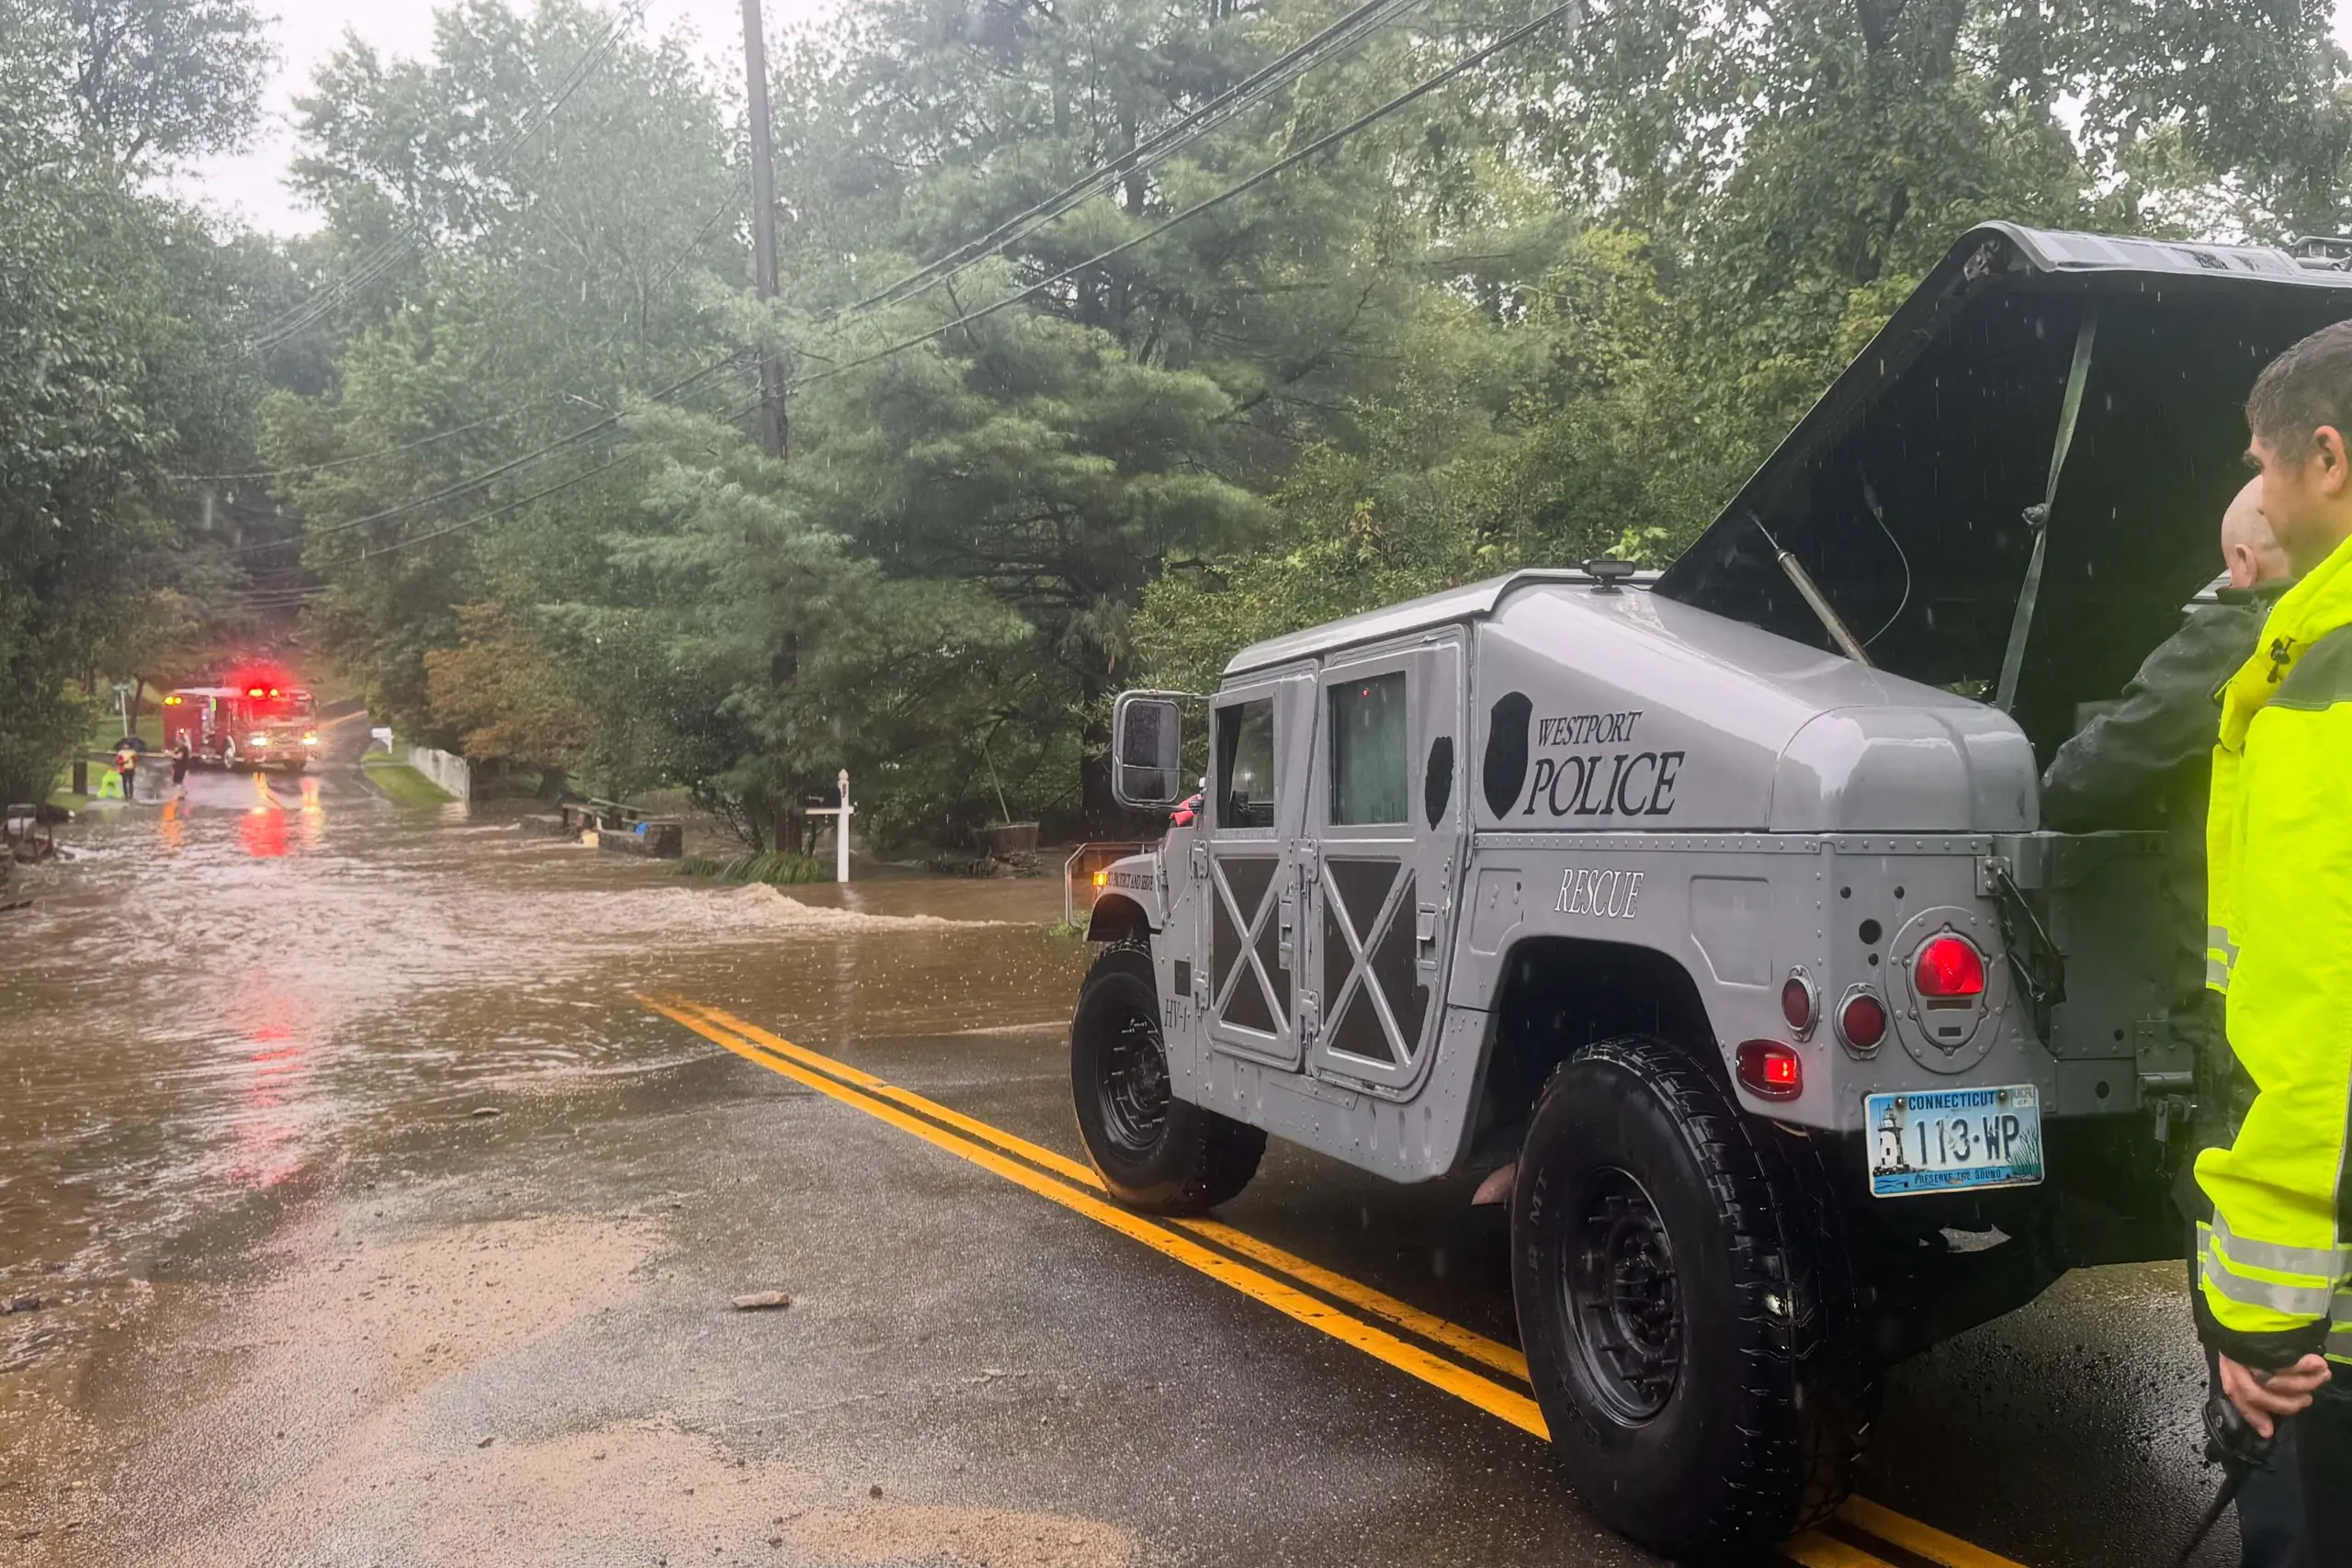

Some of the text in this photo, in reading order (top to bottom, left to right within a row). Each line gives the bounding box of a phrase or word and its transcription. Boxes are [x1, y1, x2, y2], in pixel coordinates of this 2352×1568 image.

[1538, 710, 1643, 747] WESTPORT
[1522, 751, 1686, 817] POLICE
[1131, 874, 1141, 889] AND
[1554, 868, 1644, 919] RESCUE
[1164, 998, 1187, 1033] HV-1
[1908, 1089, 1996, 1111] CONNECTICUT
[1915, 1171, 1952, 1184] PRESERVE
[1975, 1168, 2001, 1179] SOUND
